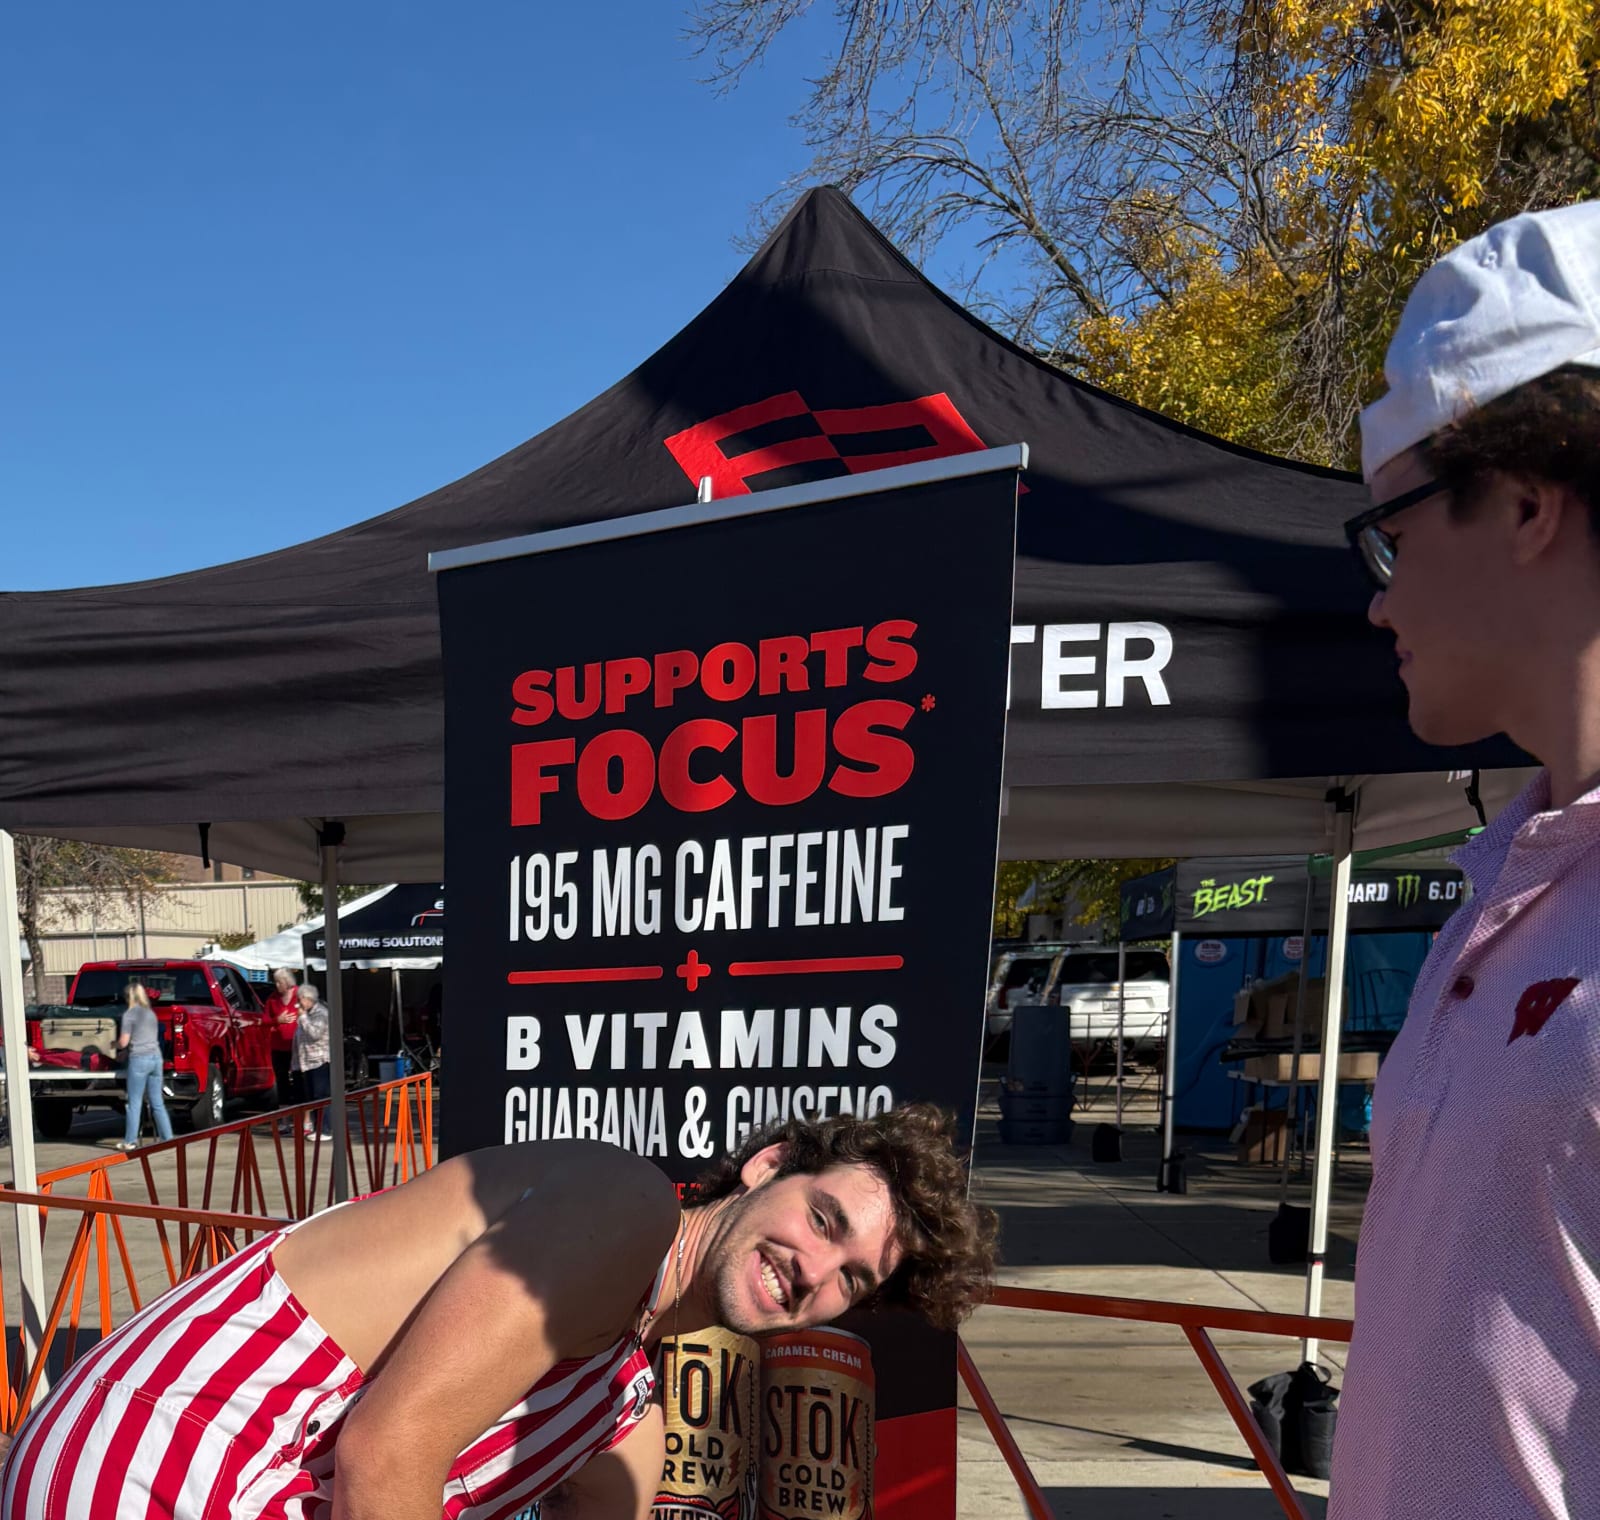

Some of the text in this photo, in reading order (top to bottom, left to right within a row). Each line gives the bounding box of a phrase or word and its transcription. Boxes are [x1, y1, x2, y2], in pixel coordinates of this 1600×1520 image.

[511, 619, 919, 726] SUPPORTS
[510, 825, 909, 941] 195 MG CAFFEINE
[1191, 875, 1274, 919] BEAST
[316, 938, 380, 950] PVIDING
[506, 1004, 897, 1071] B VITAMINS
[504, 1086, 668, 1158] GUARANA
[679, 1086, 714, 1159] &
[765, 1345, 862, 1369] CARAMEL CREAM
[665, 1432, 724, 1460] OLD
[662, 1460, 725, 1488] REW
[779, 1463, 846, 1491] COLD
[779, 1487, 846, 1516] BREW
